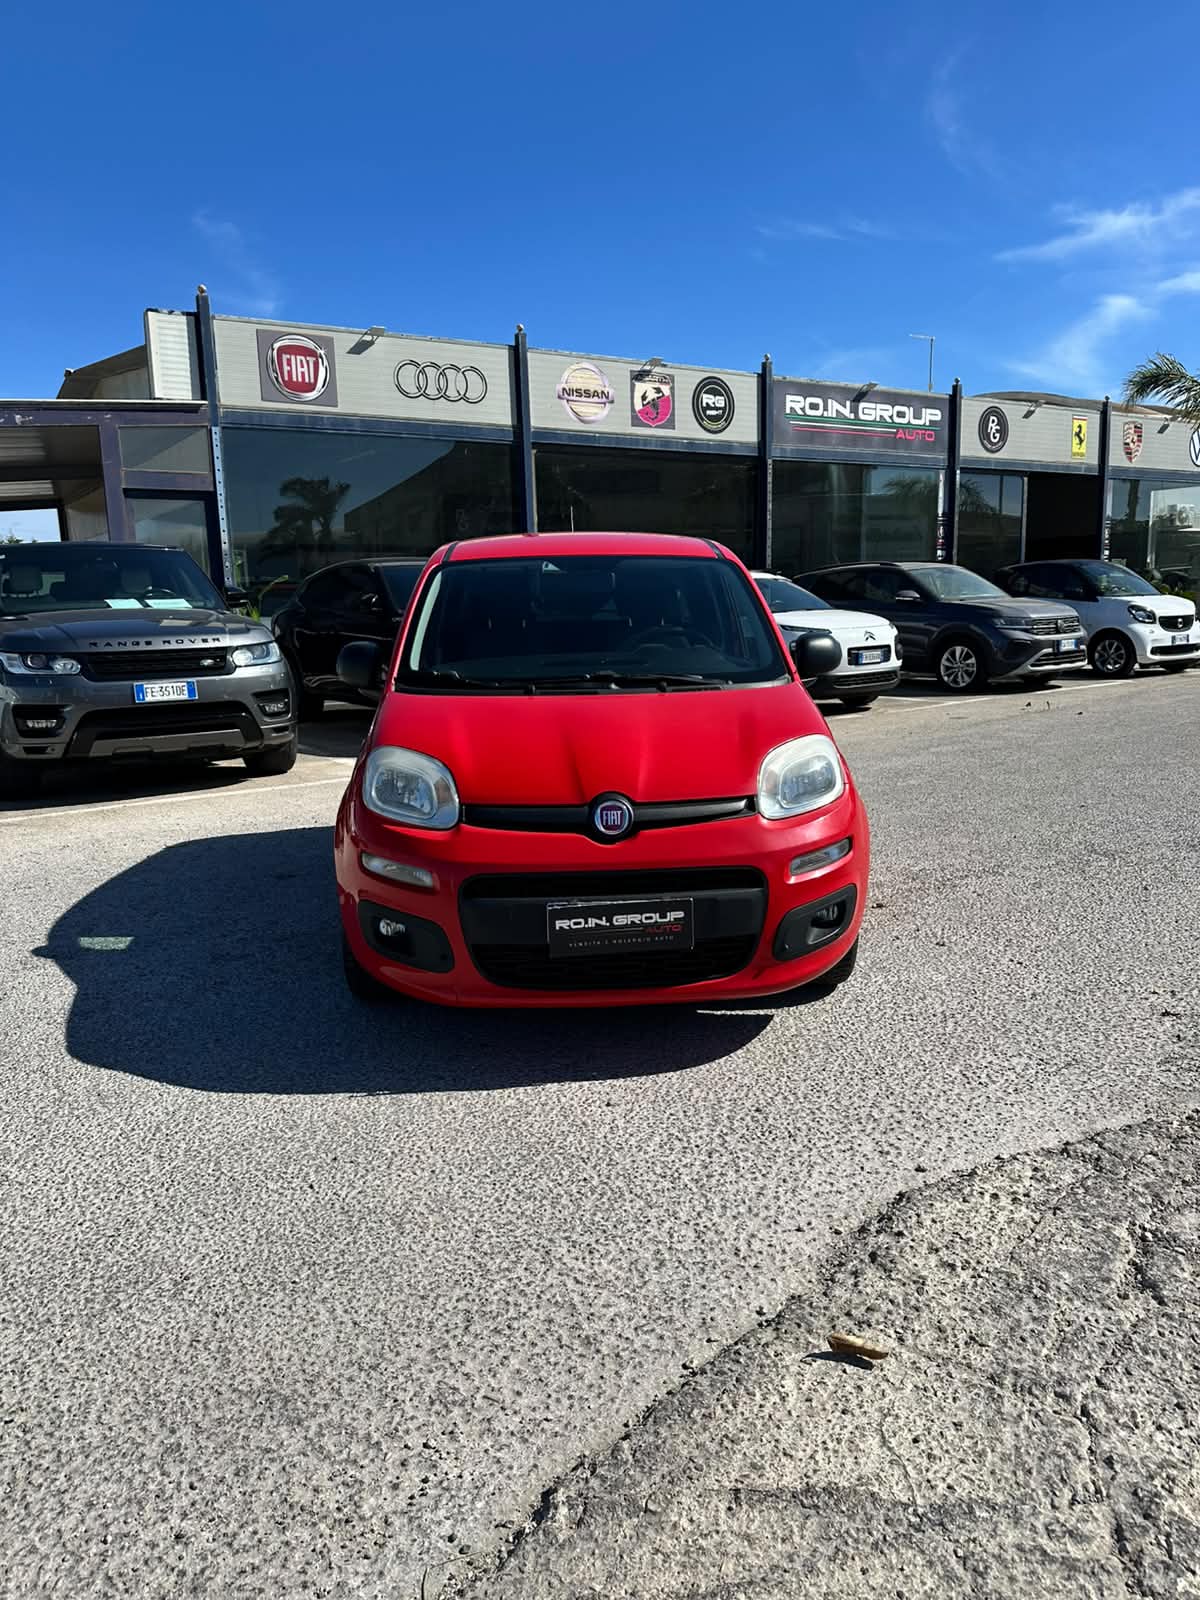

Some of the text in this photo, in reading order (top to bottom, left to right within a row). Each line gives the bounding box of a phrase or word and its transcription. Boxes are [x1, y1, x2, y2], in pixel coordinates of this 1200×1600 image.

[282, 353, 316, 384] FIAT
[561, 387, 610, 399] NISSAN
[702, 393, 725, 407] RG
[784, 394, 943, 426] RO.IN. GROUP
[896, 429, 936, 442] AUTO
[89, 639, 152, 648] RANGE
[602, 810, 622, 825] FIAT
[555, 911, 685, 930] RO.IN. GROUP
